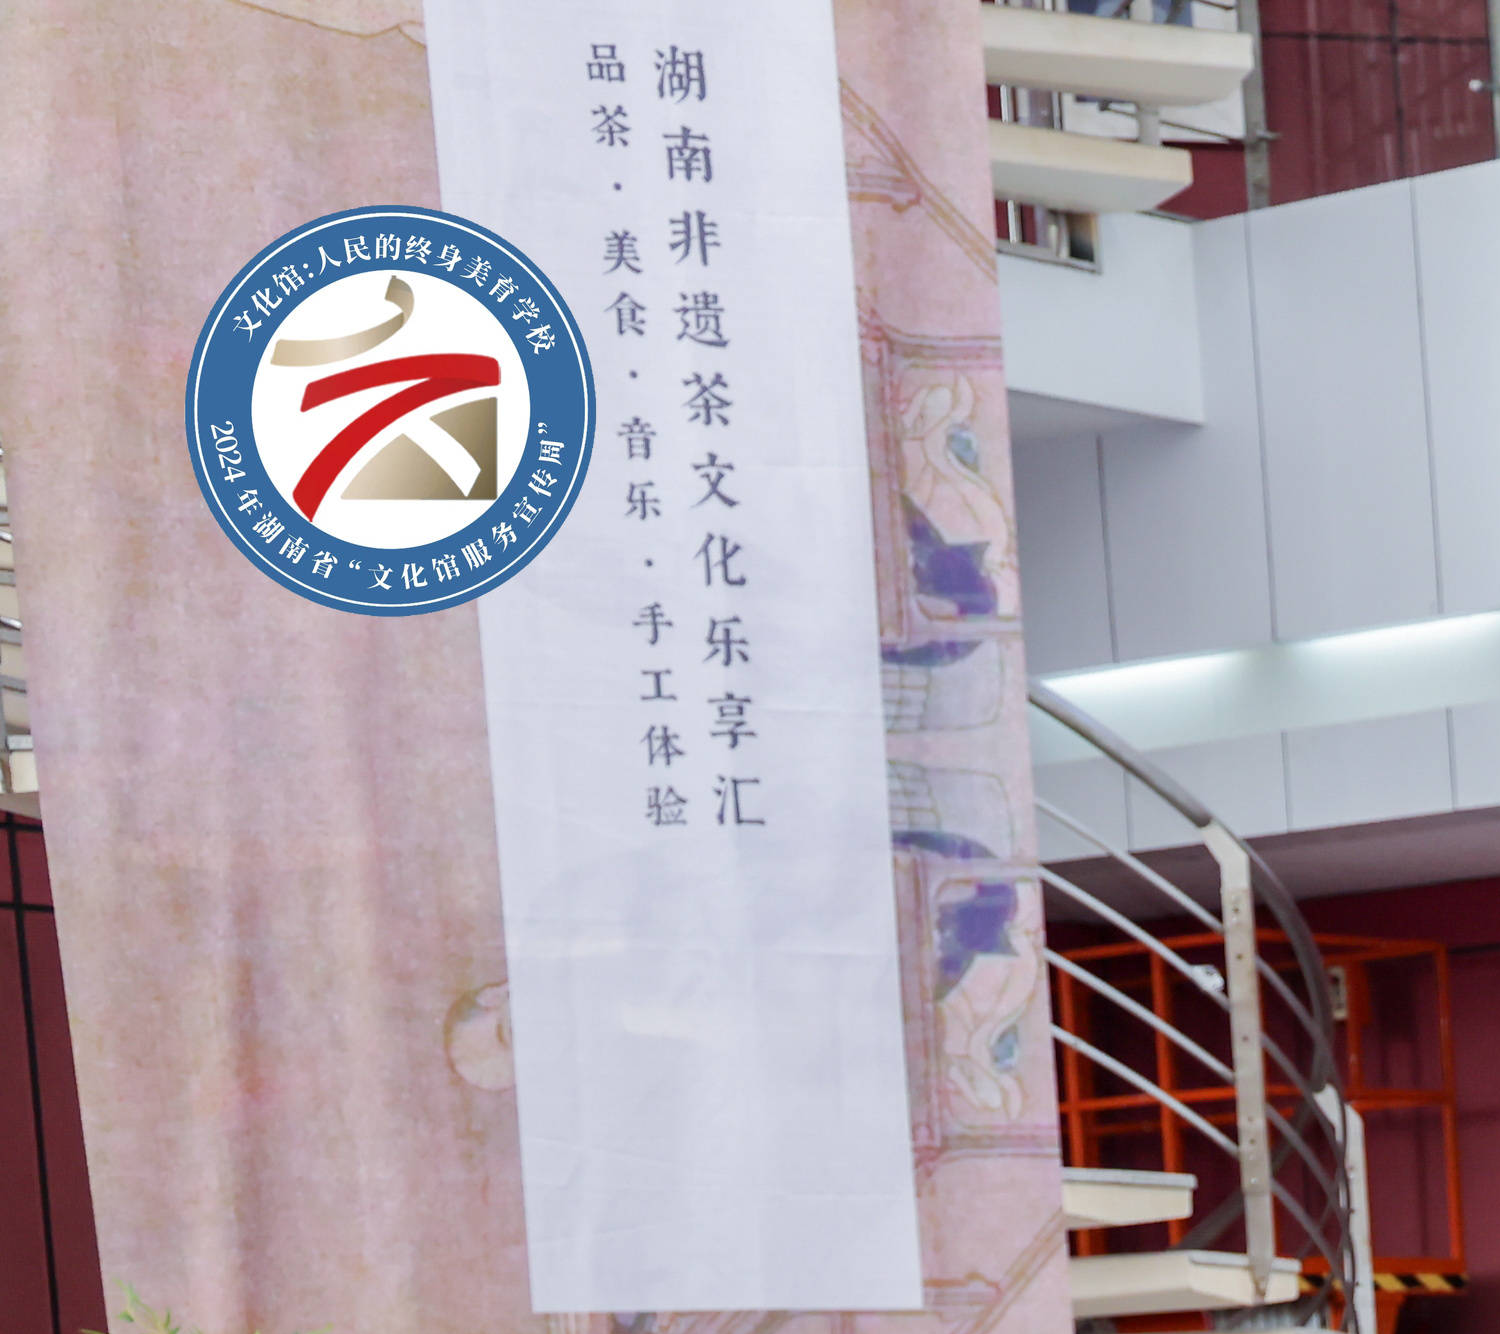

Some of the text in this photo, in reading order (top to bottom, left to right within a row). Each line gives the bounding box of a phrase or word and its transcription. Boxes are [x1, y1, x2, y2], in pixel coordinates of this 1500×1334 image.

[586, 43, 690, 828] 品茶·美食·音乐·手工体验
[654, 46, 766, 828] 湖南非遗茶文化乐享汇
